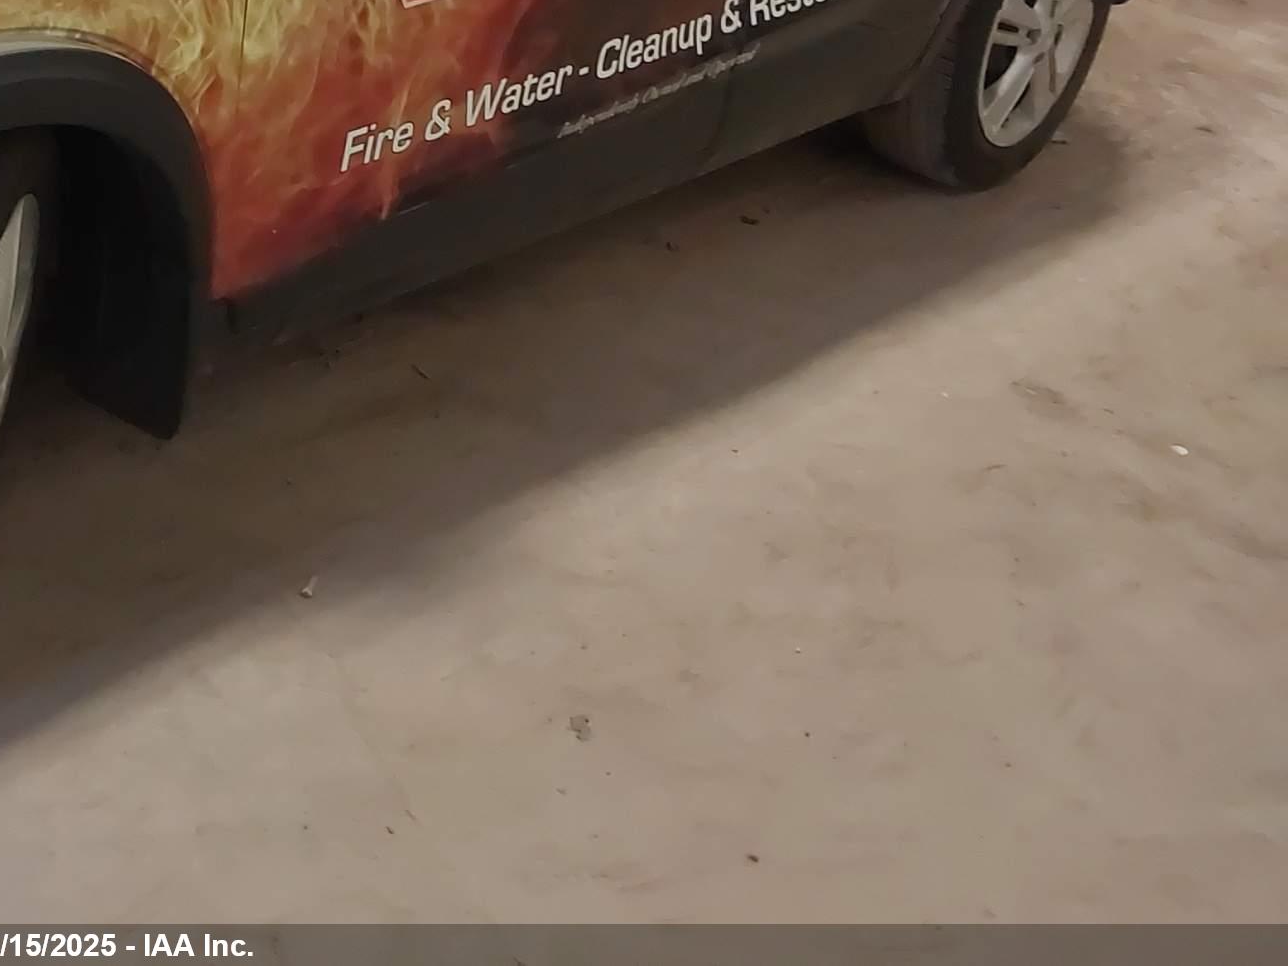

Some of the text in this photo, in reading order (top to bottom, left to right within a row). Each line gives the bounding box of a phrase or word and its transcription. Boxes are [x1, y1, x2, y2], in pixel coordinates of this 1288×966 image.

[339, 121, 414, 173] Fire
[424, 98, 452, 142] &
[464, 63, 573, 128] Water
[595, 12, 713, 80] Cleanup
